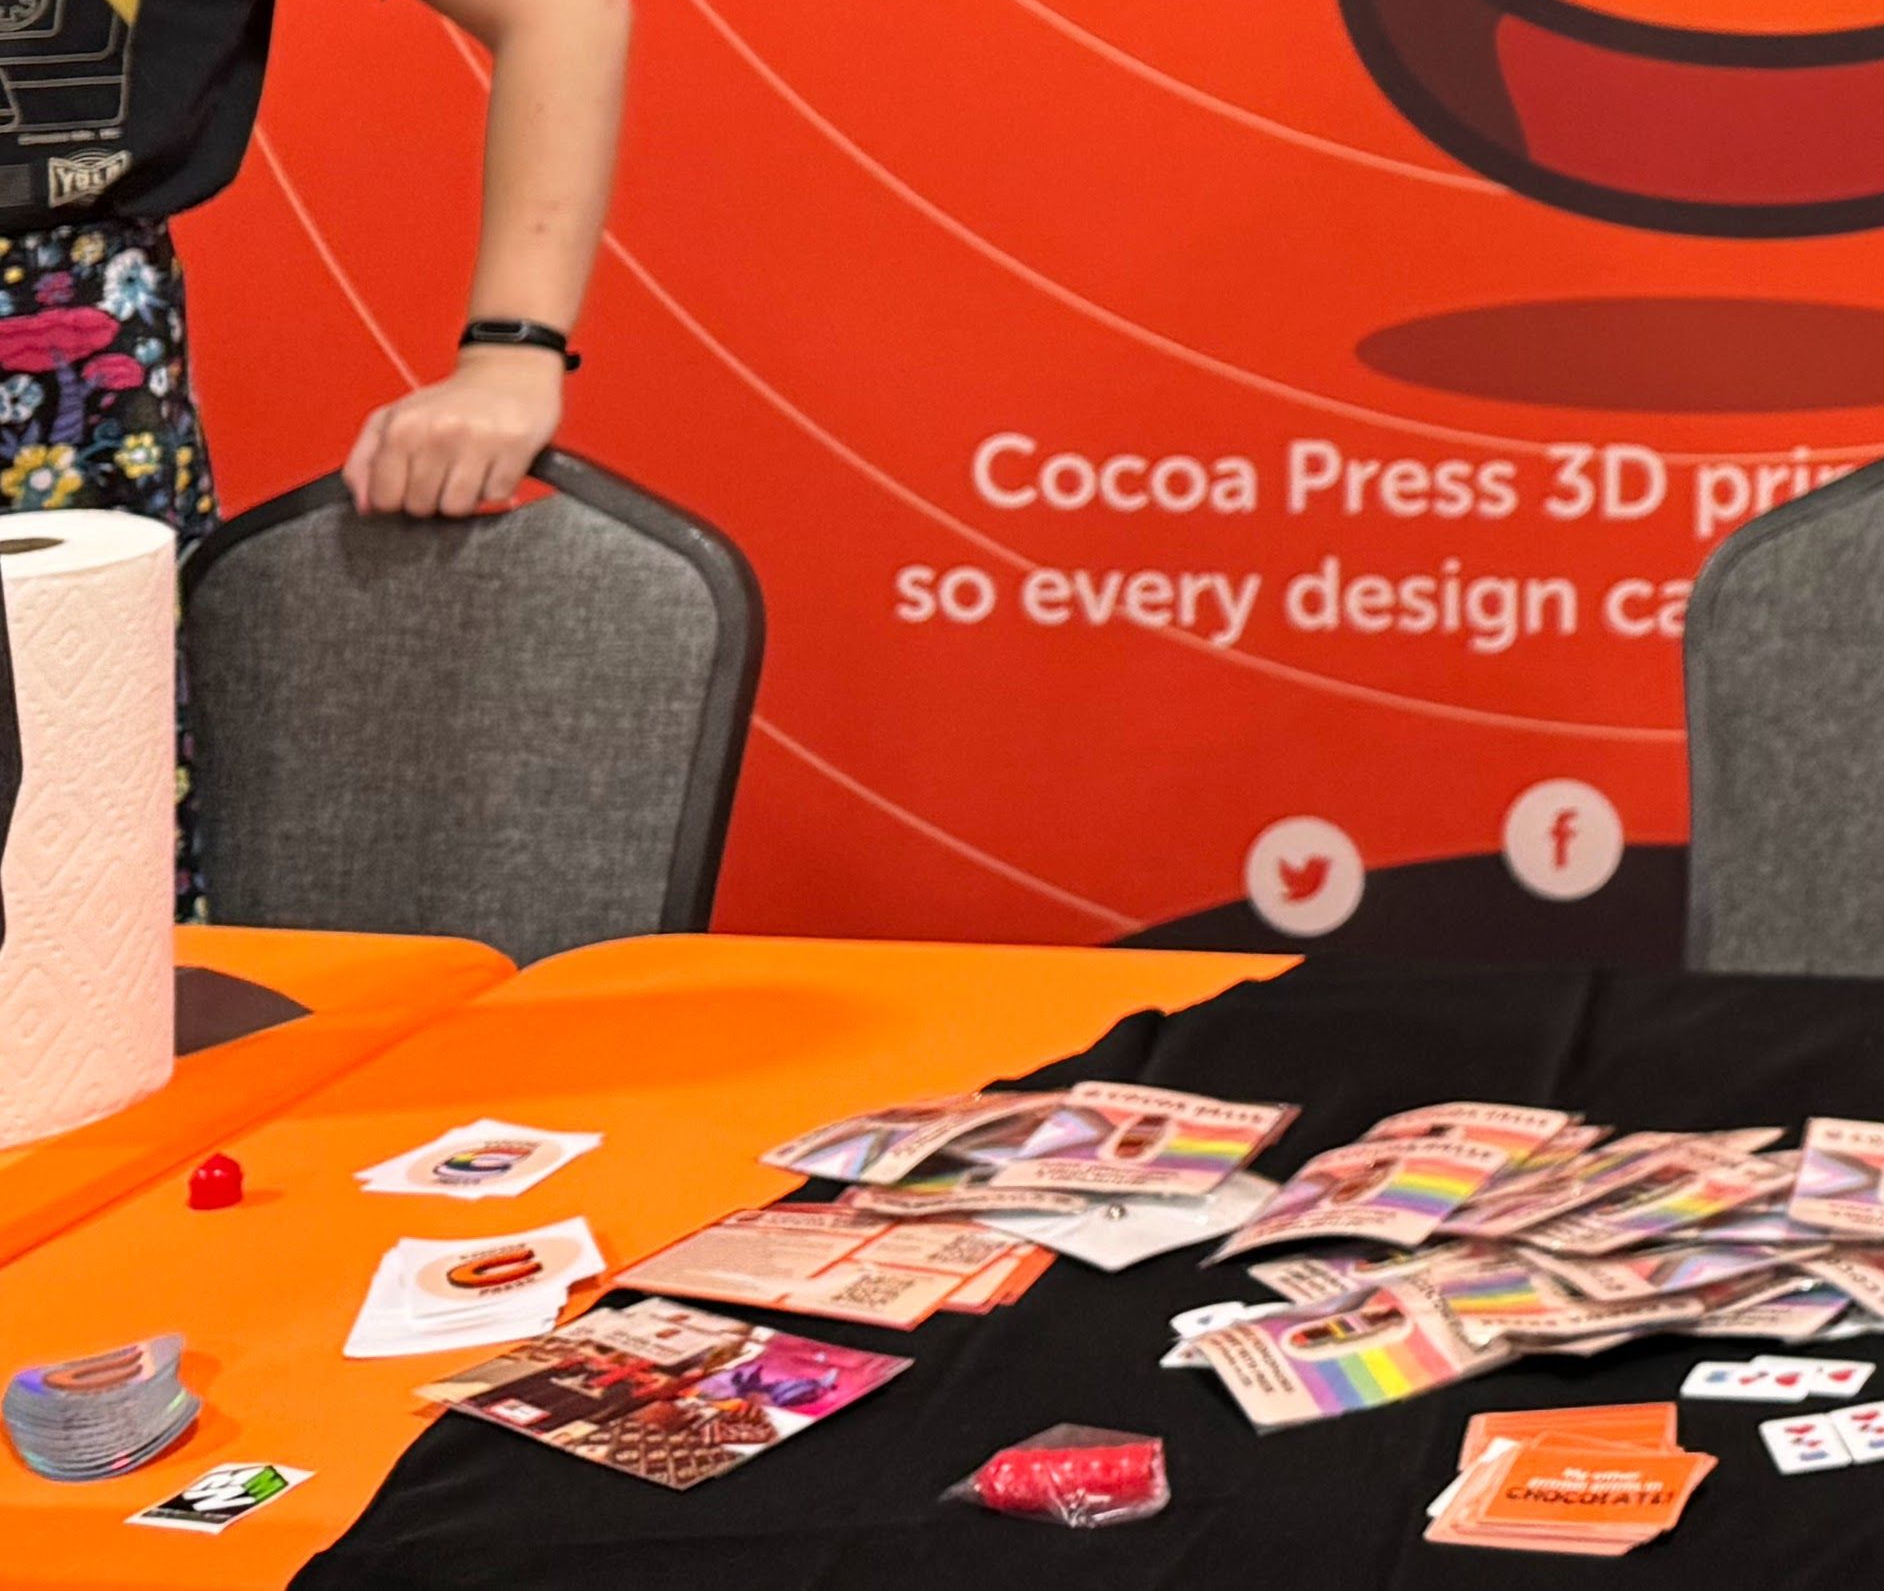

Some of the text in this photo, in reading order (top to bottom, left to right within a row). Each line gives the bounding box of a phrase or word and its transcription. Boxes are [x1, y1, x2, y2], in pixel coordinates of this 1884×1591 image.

[971, 431, 1258, 515] Cocoa
[1286, 439, 1518, 519] Press
[1543, 441, 1669, 520] 3D
[894, 563, 995, 623] so
[1021, 563, 1262, 649] every
[1286, 556, 1577, 655] design
